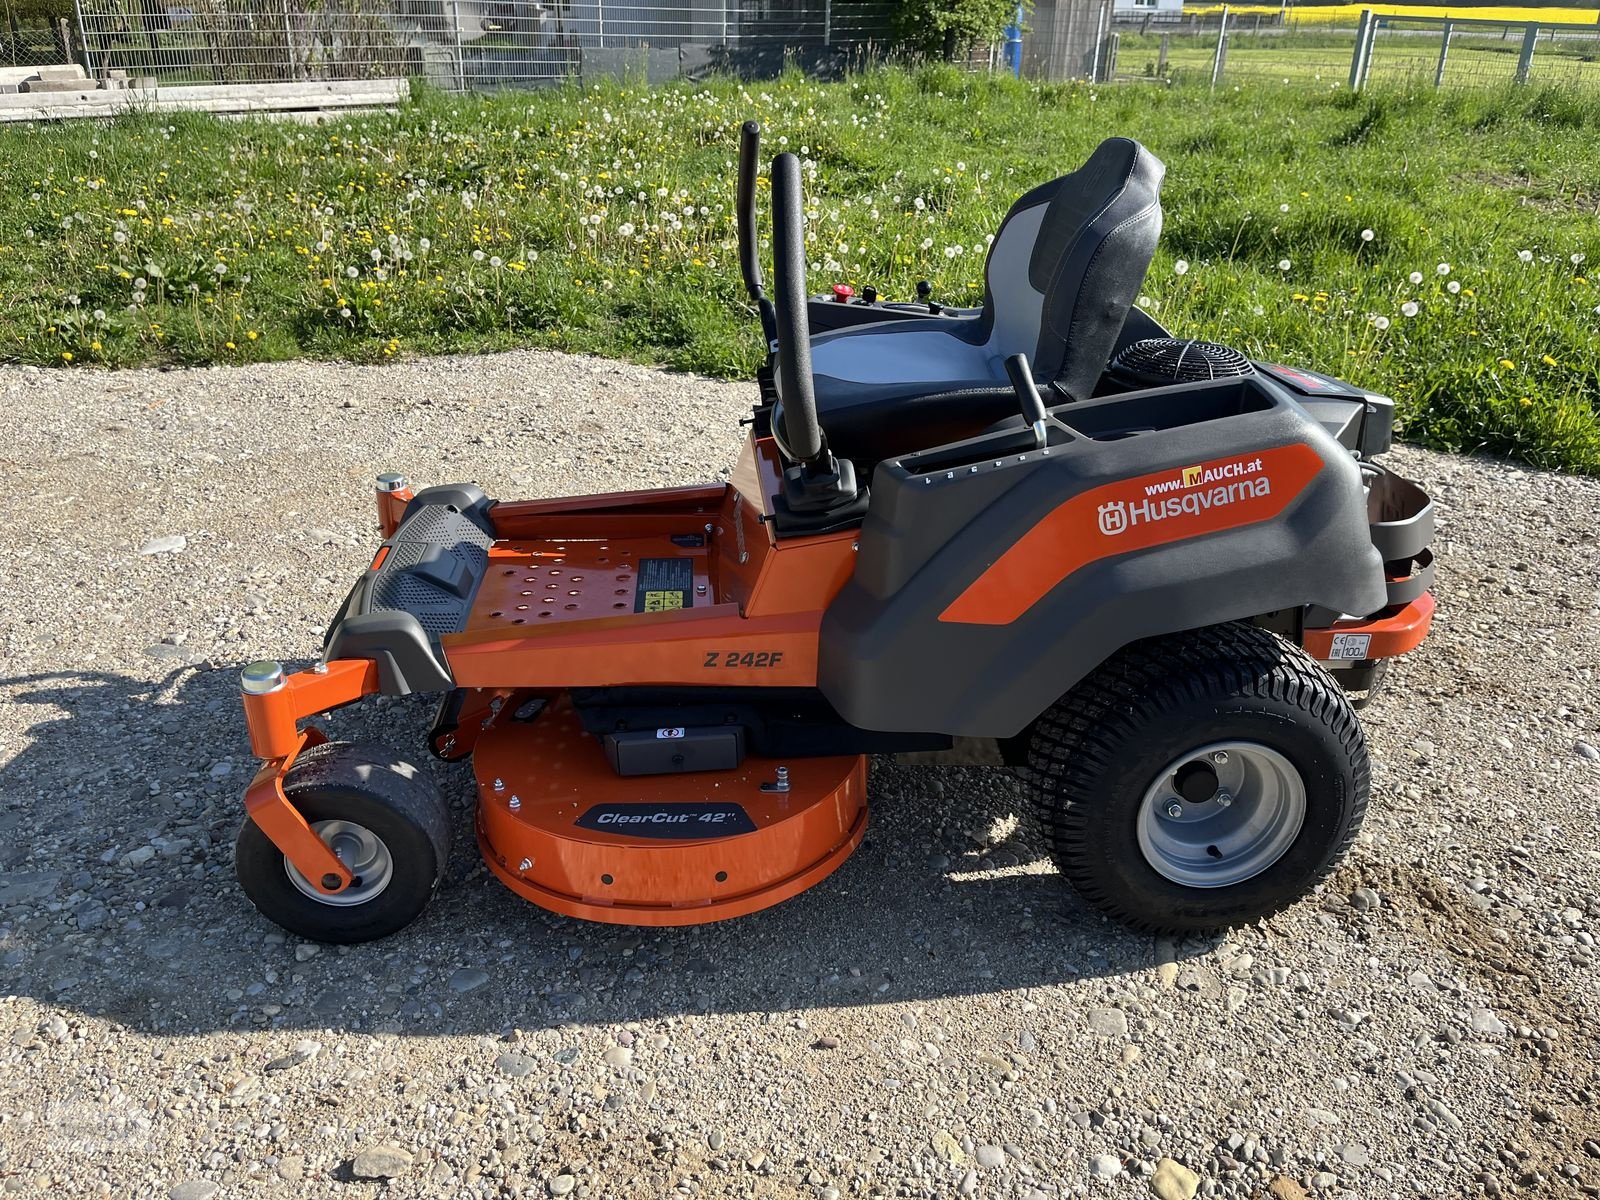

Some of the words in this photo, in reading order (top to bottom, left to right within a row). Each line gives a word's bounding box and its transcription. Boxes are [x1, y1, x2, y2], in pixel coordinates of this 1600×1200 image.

[1144, 458, 1262, 496] www.MAUCH.at
[1129, 476, 1270, 525] Husqvarna
[703, 652, 720, 667] Z
[725, 652, 783, 667] 242F
[1345, 647, 1360, 657] 100
